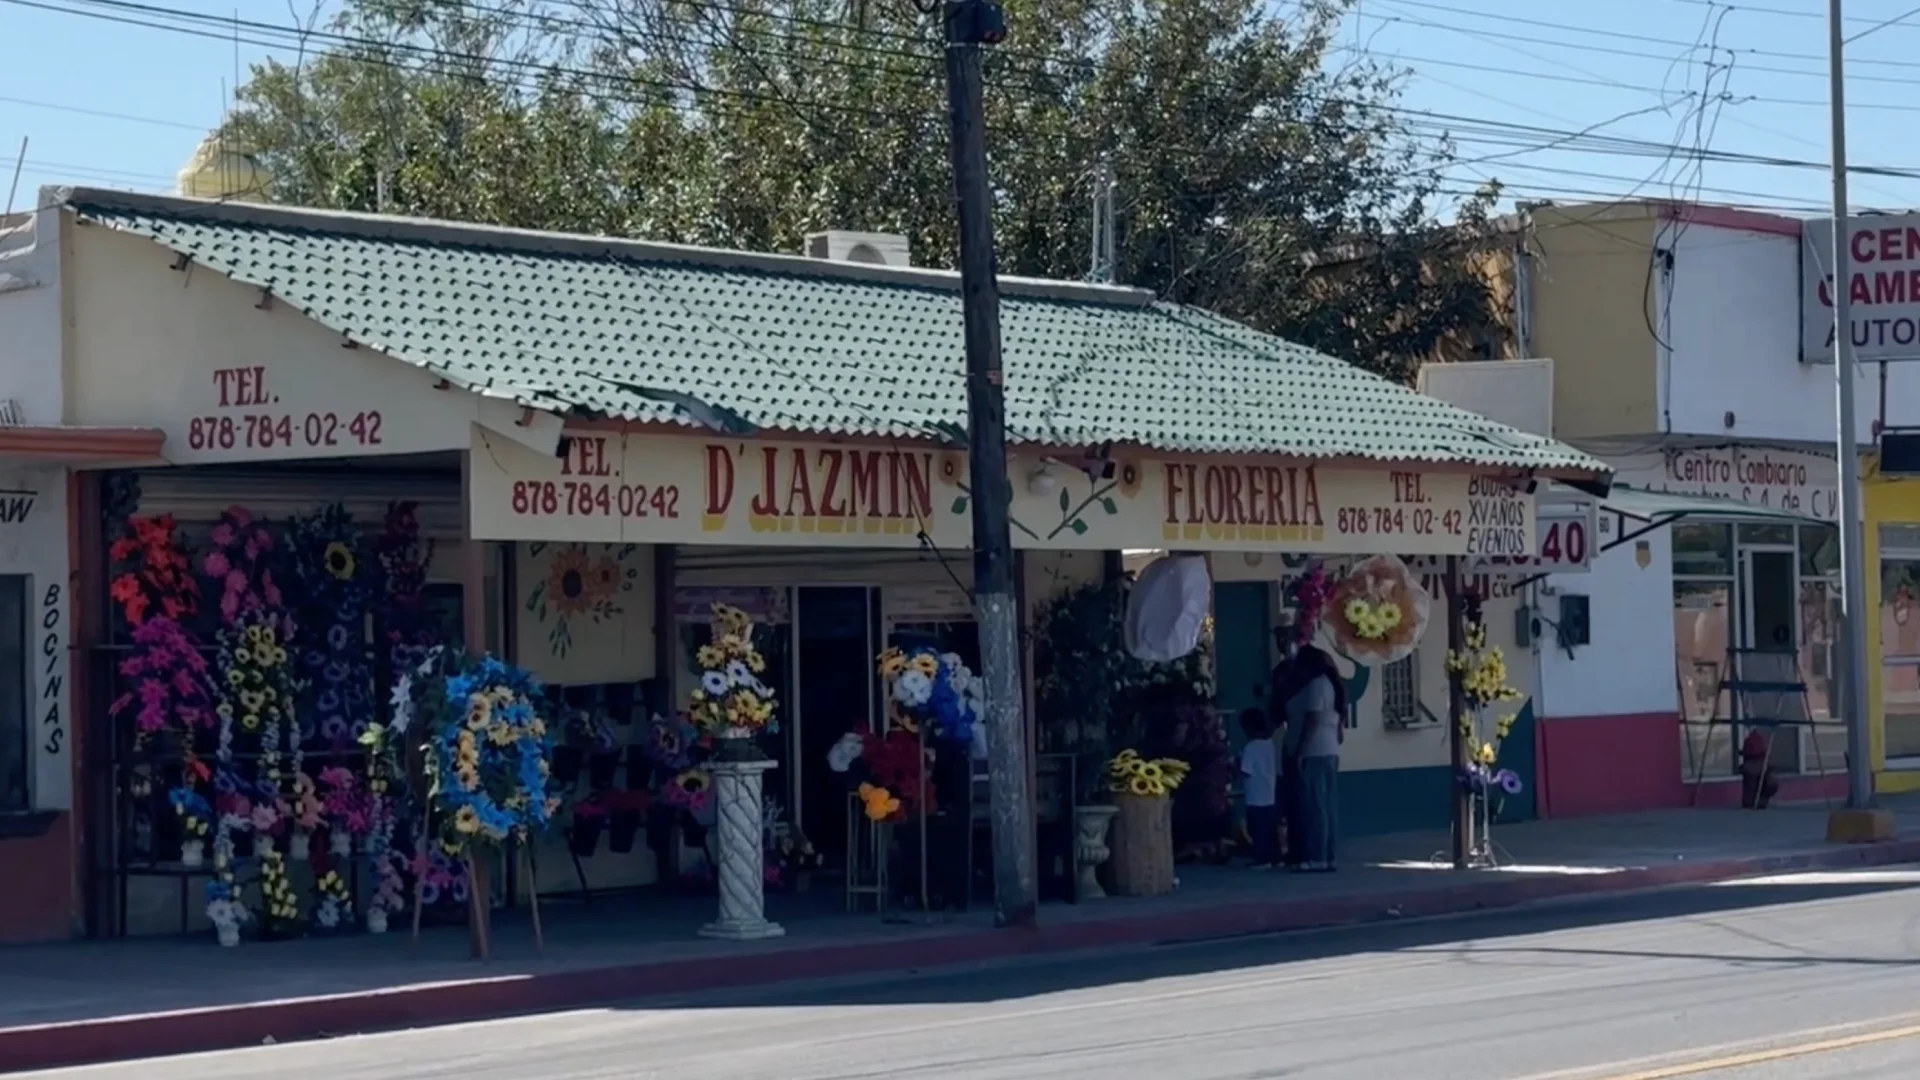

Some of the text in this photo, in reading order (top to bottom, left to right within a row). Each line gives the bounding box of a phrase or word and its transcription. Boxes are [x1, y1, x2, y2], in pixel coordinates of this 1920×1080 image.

[1825, 317, 1920, 348] UTO
[213, 366, 279, 407] TEL.
[189, 410, 382, 450] 878-784-02-42
[557, 436, 620, 476] TEL.
[1673, 452, 1730, 483] Centro
[512, 480, 679, 518] 878-784-0242
[1390, 471, 1432, 503] TEL.
[1338, 507, 1462, 535] 878-784-02-42
[1467, 527, 1525, 554] EVENTOS
[43, 583, 63, 754] BOCINAS
